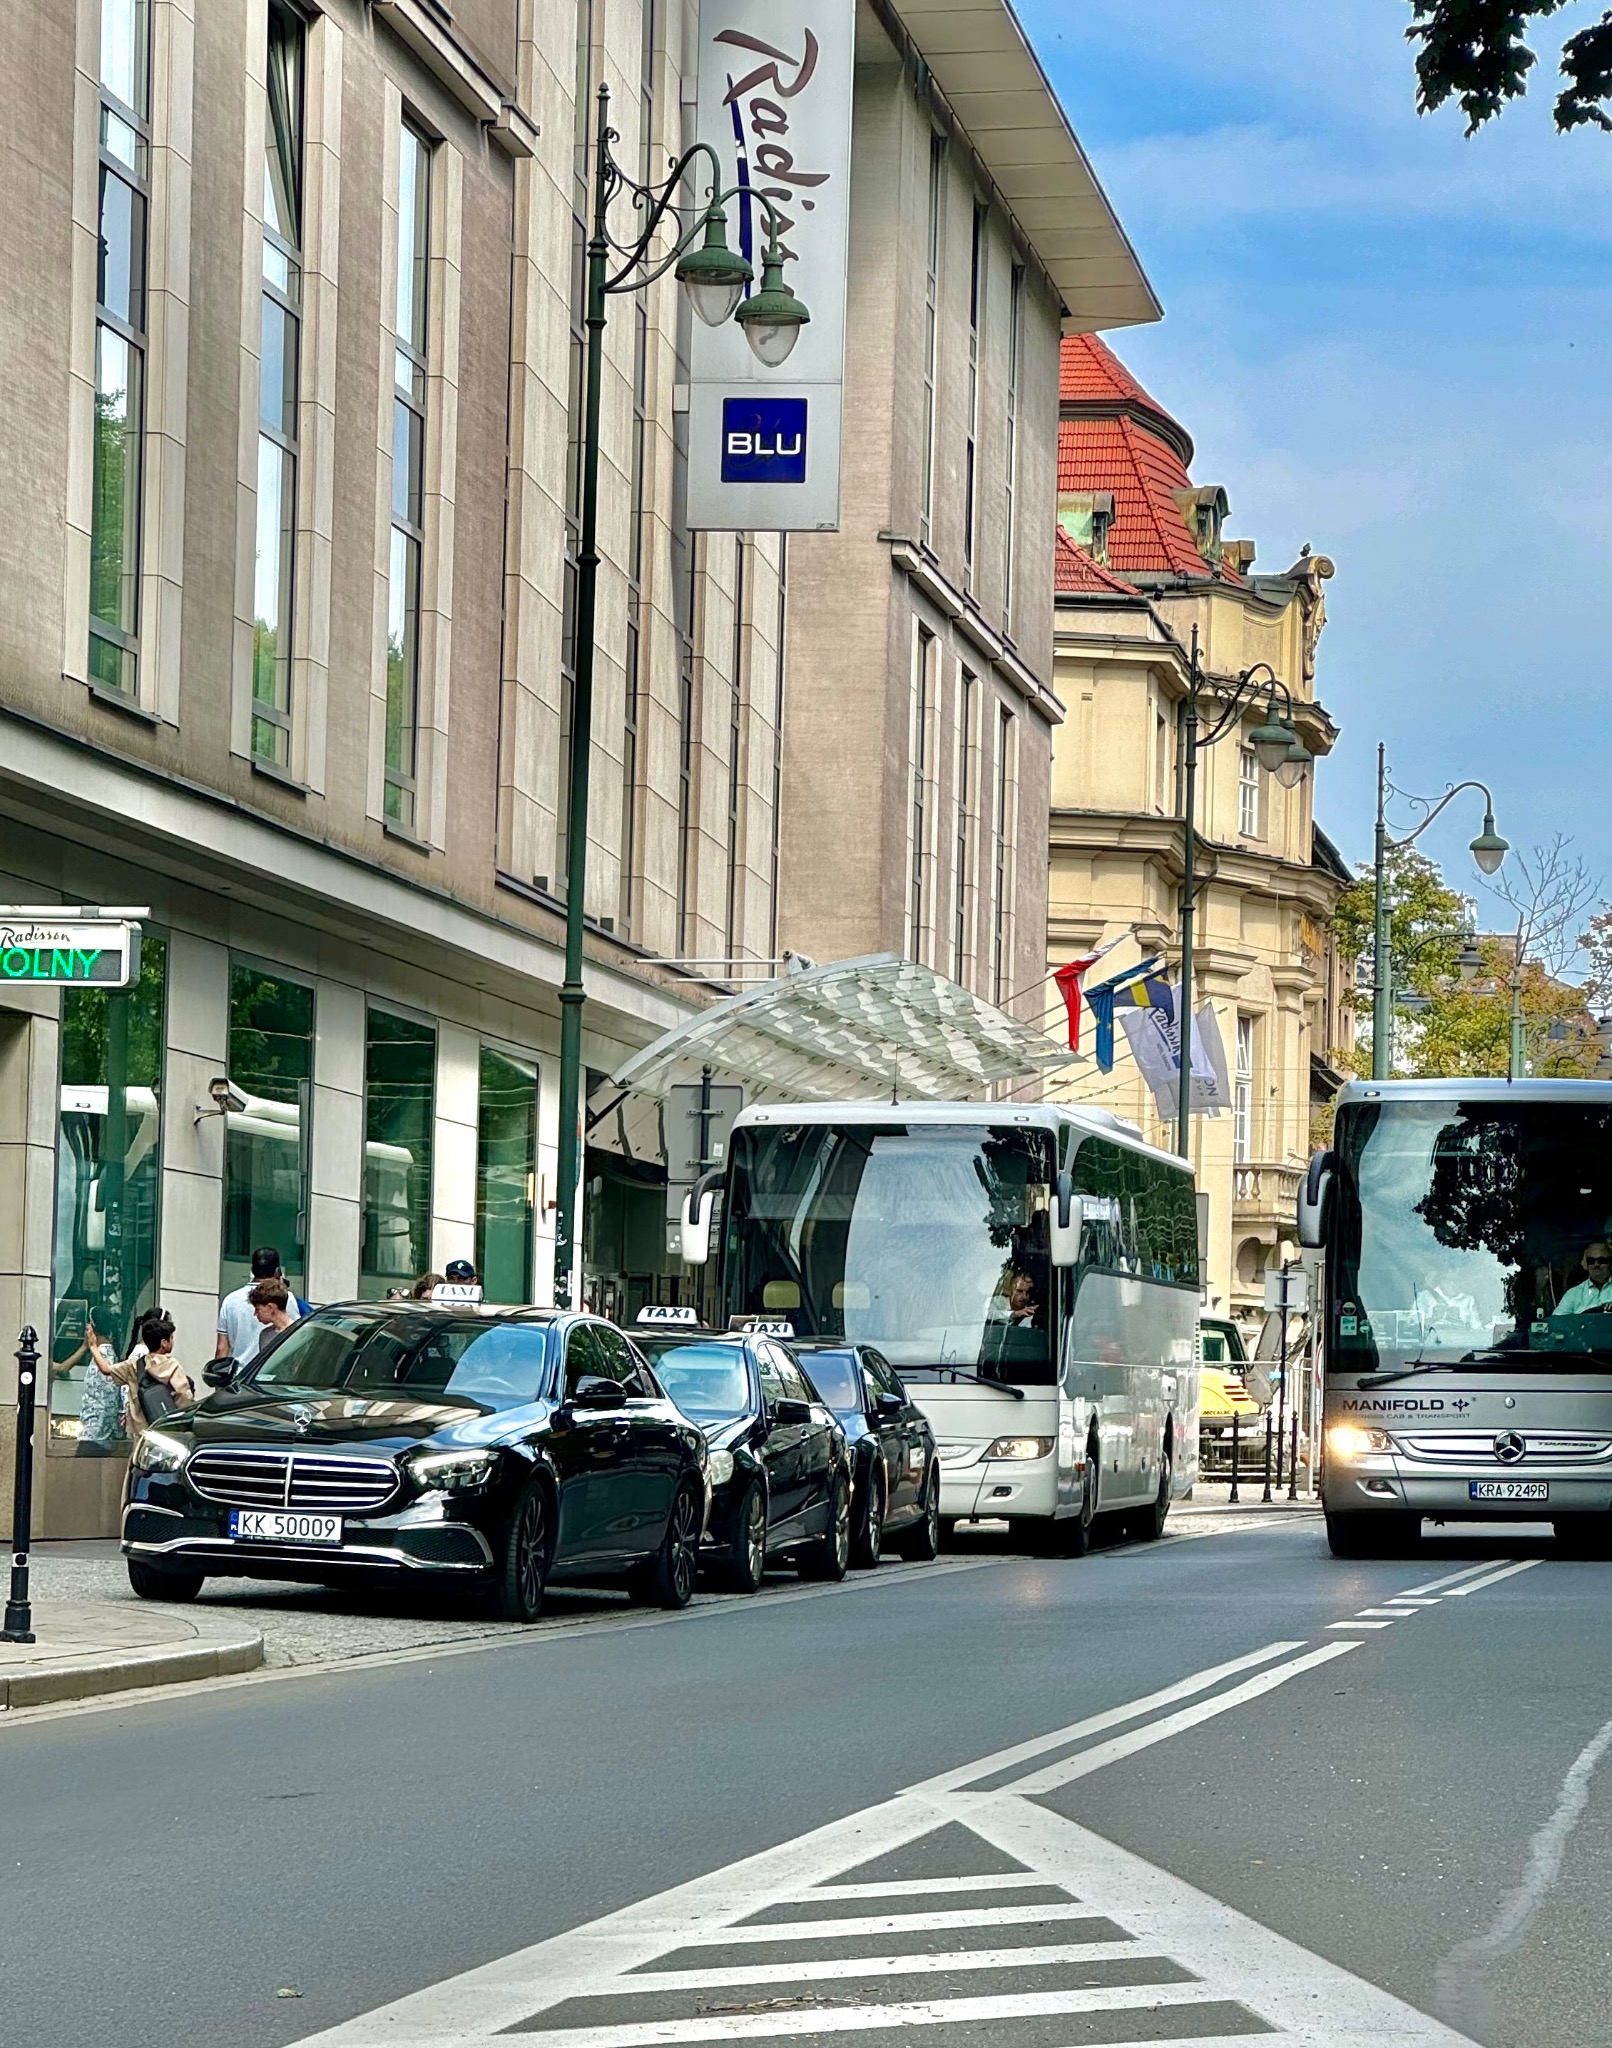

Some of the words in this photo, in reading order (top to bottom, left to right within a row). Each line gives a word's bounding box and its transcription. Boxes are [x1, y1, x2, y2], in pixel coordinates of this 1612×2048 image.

[727, 432, 802, 455] BLU
[0, 923, 71, 948] Radisson
[0, 947, 102, 978] OLNY
[645, 1307, 690, 1319] TAXI
[747, 1323, 788, 1334] TAXI
[1342, 1399, 1445, 1411] MANIFOLD
[1478, 1483, 1503, 1497] KRA
[1506, 1483, 1547, 1498] 9249R
[242, 1513, 267, 1535] KK
[274, 1515, 336, 1538] 50009
